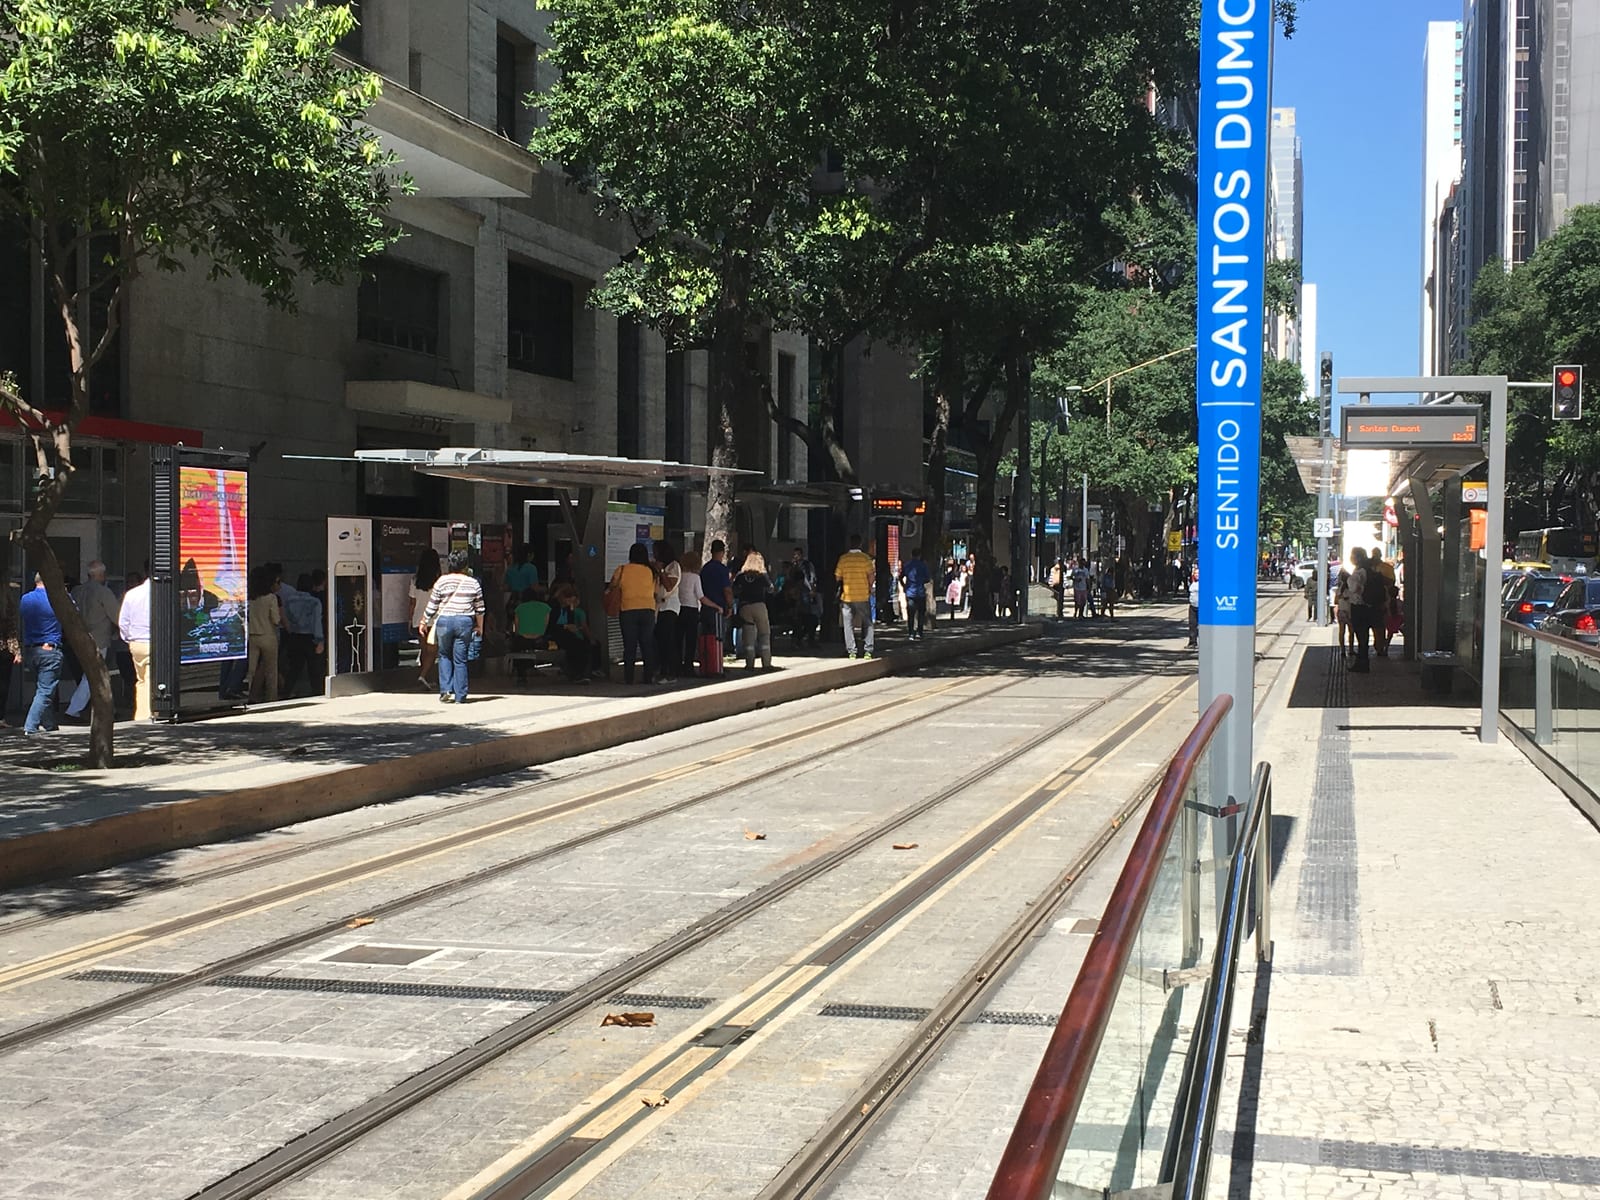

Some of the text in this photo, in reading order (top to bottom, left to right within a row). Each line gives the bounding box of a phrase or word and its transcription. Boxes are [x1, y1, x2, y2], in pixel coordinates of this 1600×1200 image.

[1210, 0, 1256, 549] SENTIDO SANTOS DUMO
[1317, 522, 1330, 533] 25
[1215, 595, 1239, 606] VLT
